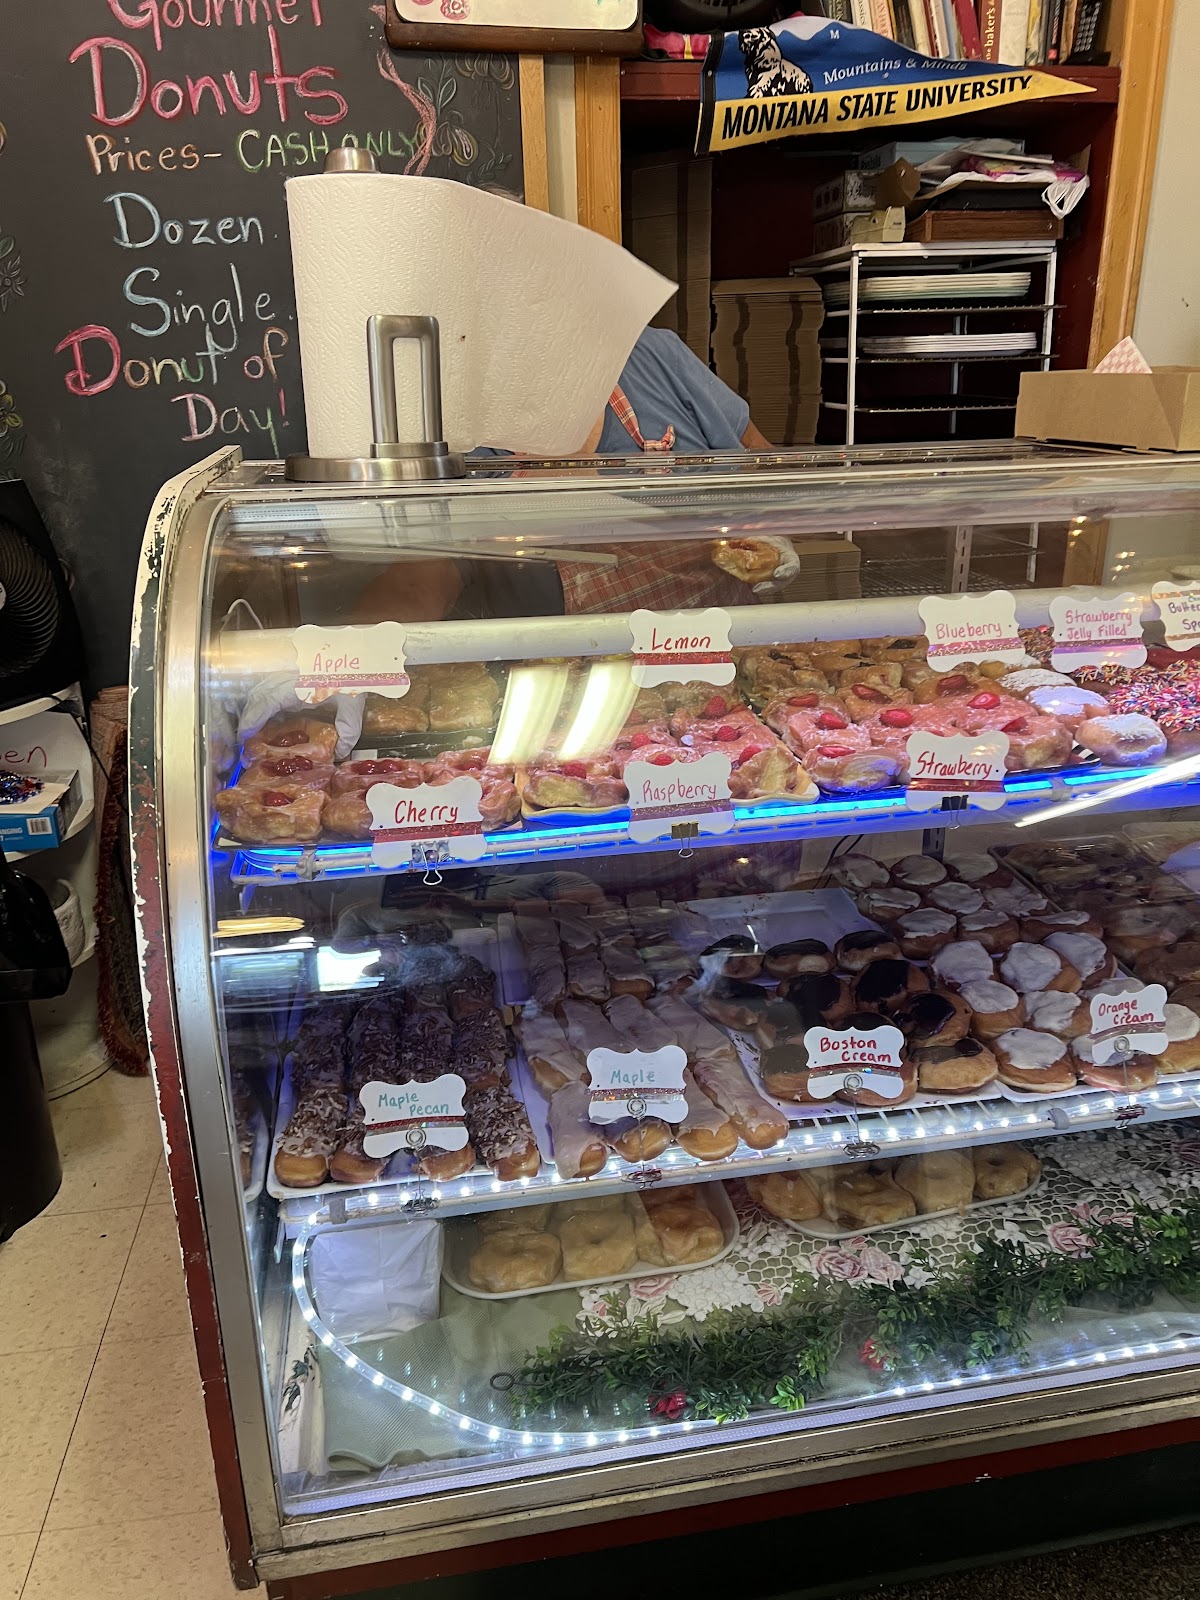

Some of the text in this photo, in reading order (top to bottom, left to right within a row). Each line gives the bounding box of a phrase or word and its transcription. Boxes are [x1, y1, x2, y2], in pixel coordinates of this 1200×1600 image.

[830, 30, 840, 39] M
[69, 25, 348, 126] Donuts
[823, 58, 968, 85] Mountains & Minds
[722, 75, 1032, 140] MONTANA STATE UNIVERSITY
[237, 129, 330, 172] CASH
[55, 323, 289, 396] Donut of
[171, 388, 290, 459] Day!
[1065, 609, 1132, 626] Strawberry
[651, 628, 711, 651] Lemon
[936, 622, 1003, 639] Blueberry
[1067, 624, 1127, 640] Jelly Filled
[313, 653, 360, 672] Apple
[916, 750, 993, 779] Strawberry
[643, 778, 717, 803] Raspberry
[394, 800, 458, 824] Cherry
[1098, 999, 1138, 1016] Orange
[1113, 1012, 1154, 1025] Cream
[820, 1036, 877, 1052] Boston
[841, 1051, 891, 1063] Cream
[610, 1069, 655, 1086] Maple
[378, 1092, 419, 1110] Maple
